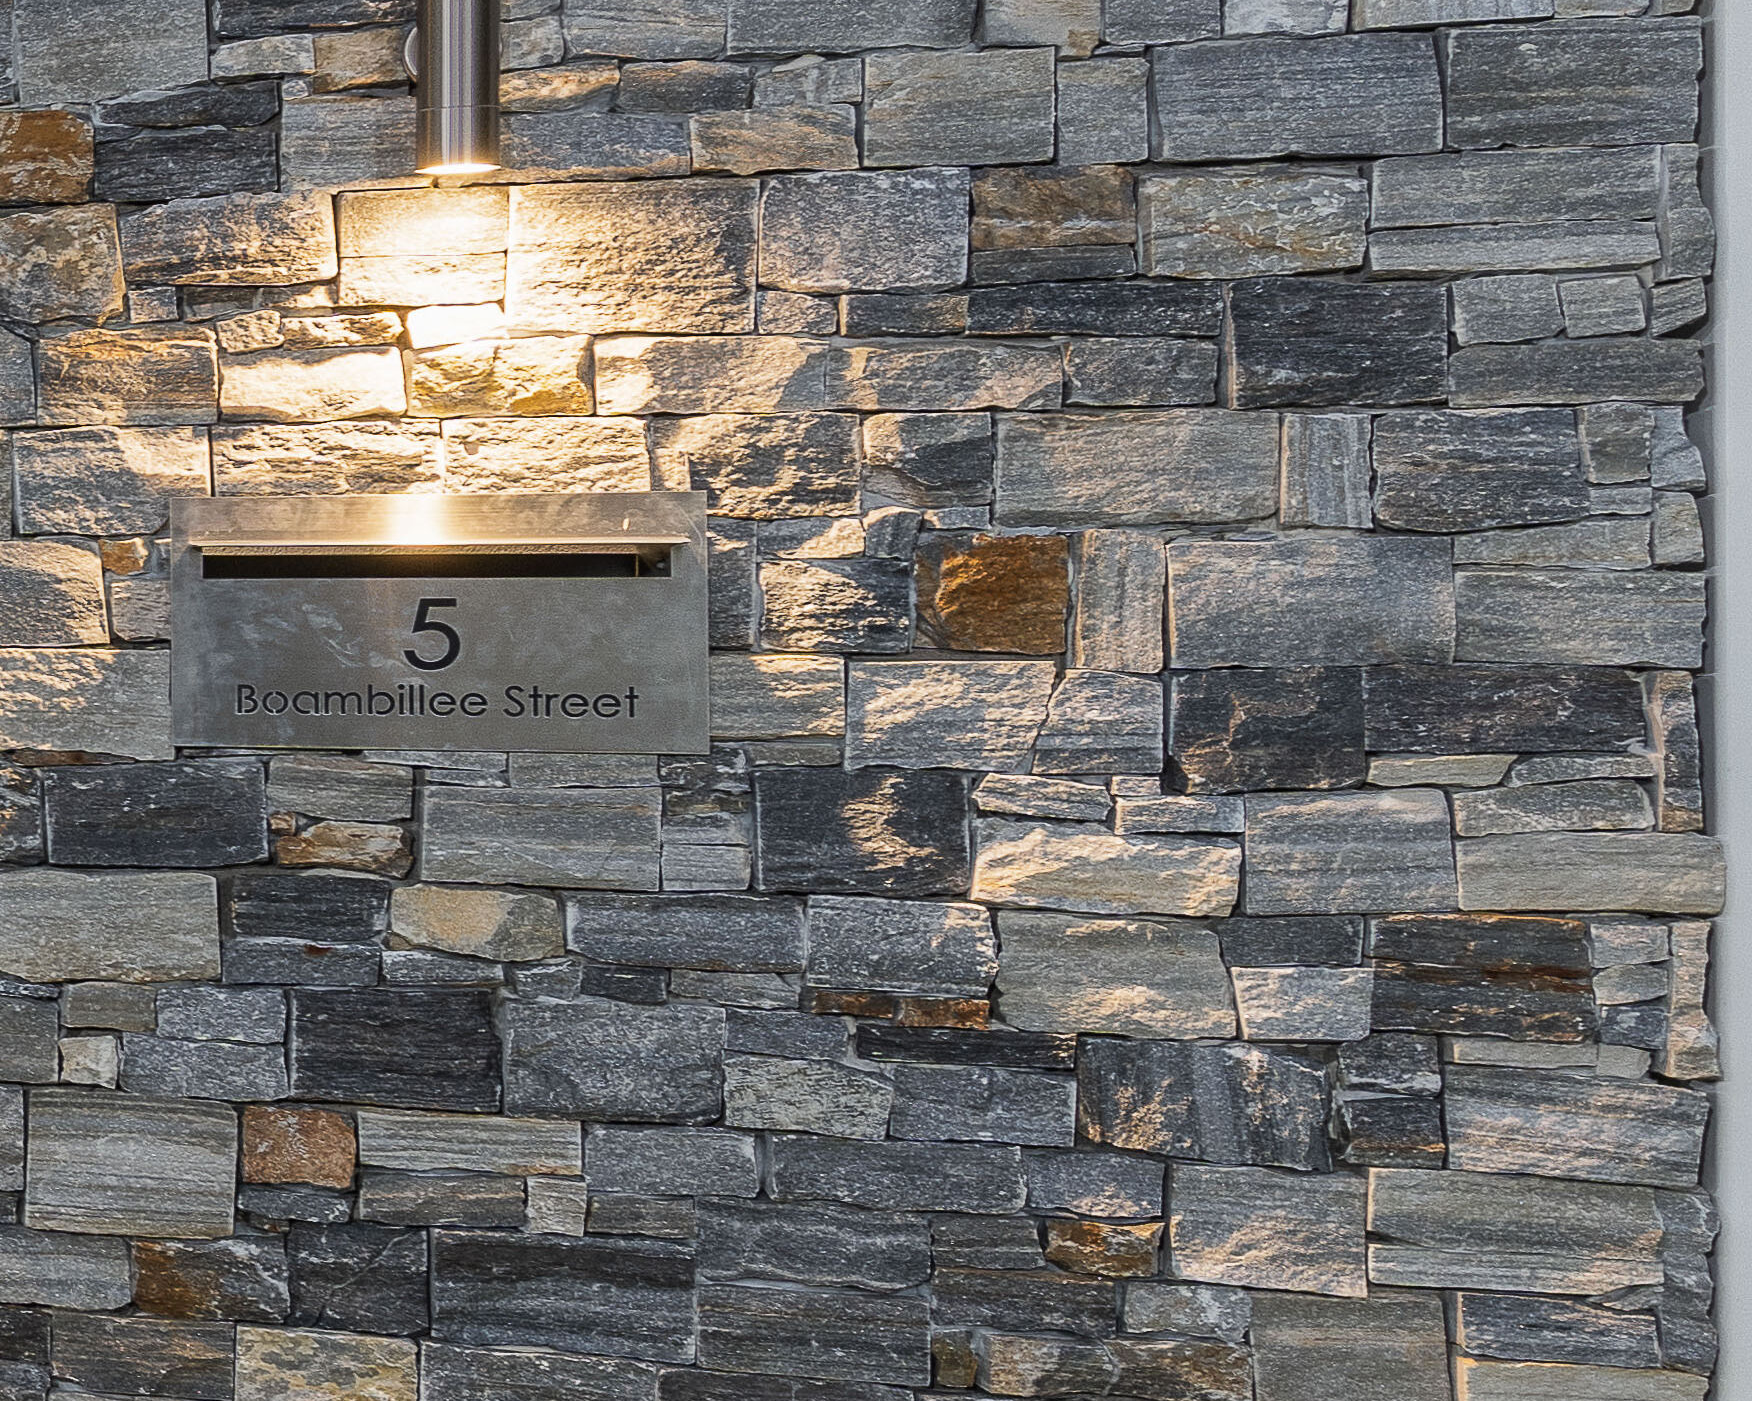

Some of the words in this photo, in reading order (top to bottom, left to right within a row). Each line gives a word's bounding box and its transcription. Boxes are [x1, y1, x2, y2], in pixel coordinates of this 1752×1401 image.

[403, 597, 461, 671] 5
[235, 683, 488, 717] Boambillee
[503, 684, 640, 719] Street
